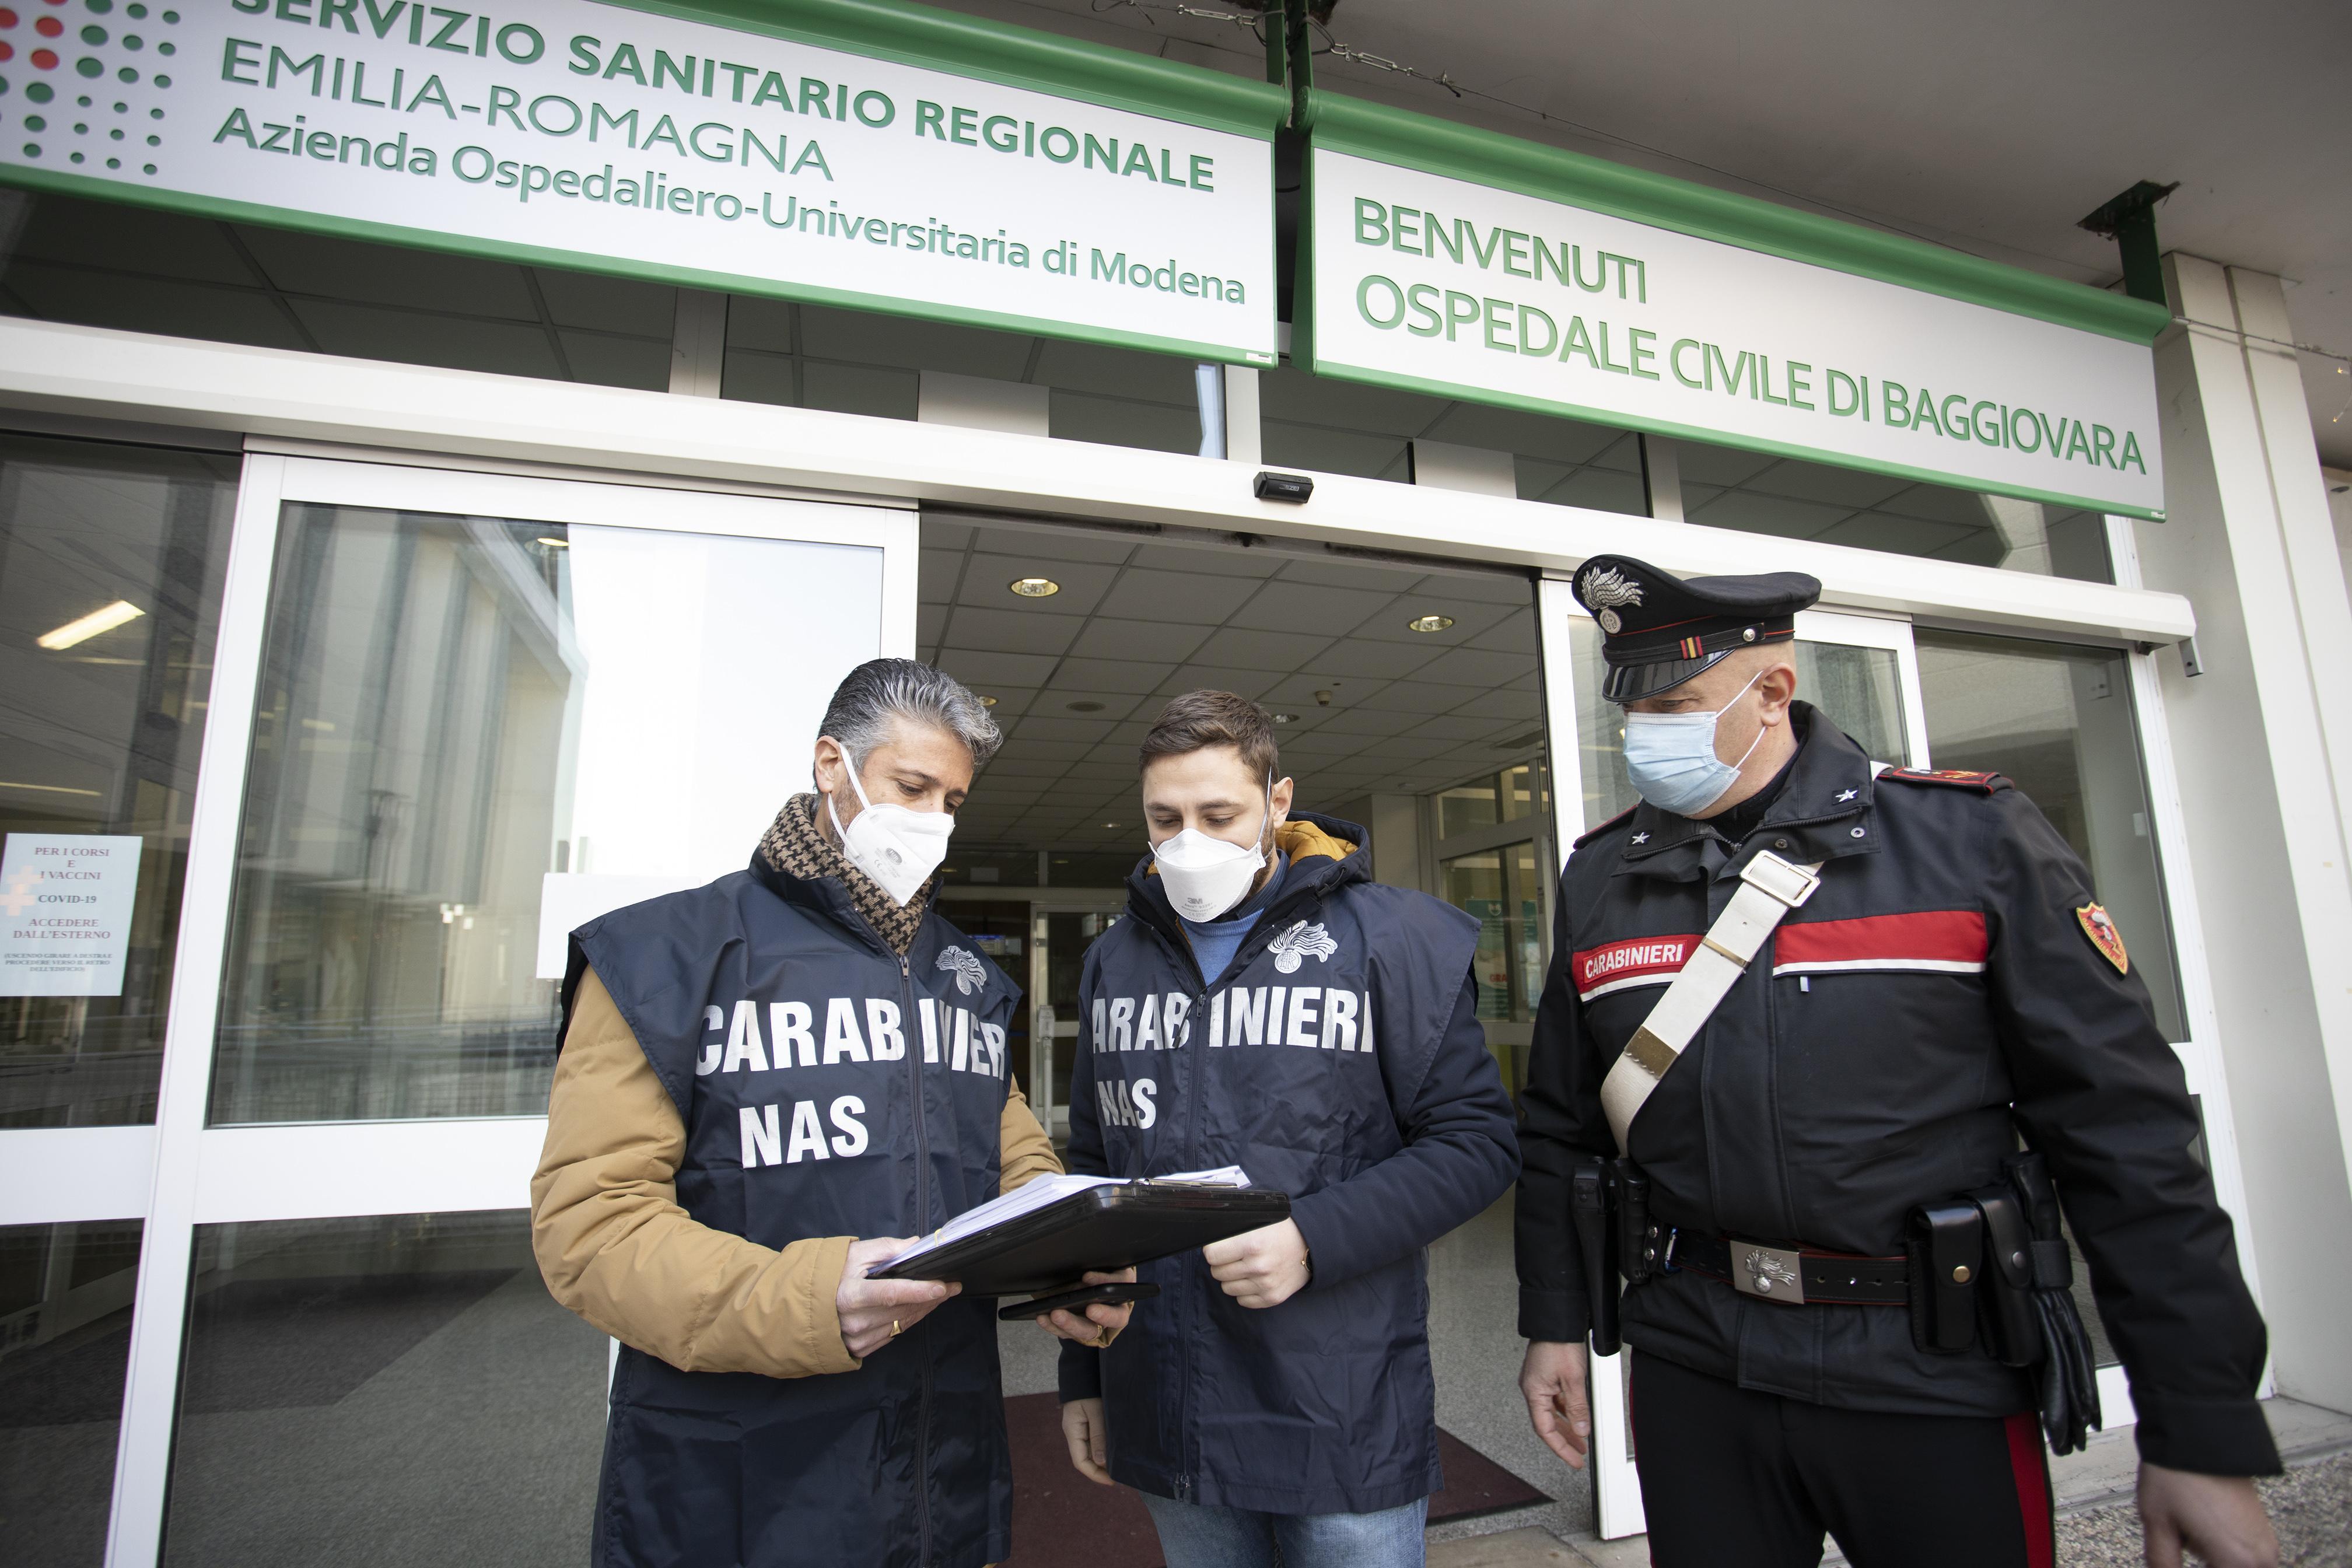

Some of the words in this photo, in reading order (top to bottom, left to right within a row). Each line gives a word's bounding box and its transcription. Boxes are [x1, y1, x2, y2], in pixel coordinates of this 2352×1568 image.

[221, 37, 834, 181] EMILIA-ROMAGNA
[568, 35, 895, 128] SANITARIO
[915, 99, 1215, 193] REGIONALE
[213, 107, 438, 177] Azienda
[452, 146, 1030, 269] Ospedaliero-Universitaria
[1042, 242, 1077, 278] di
[1091, 249, 1246, 304] Modena
[1354, 197, 1647, 304] BENVENUTI
[1356, 274, 1660, 382] OSPEDALE
[1670, 338, 1815, 412] CIVILE
[1826, 368, 1870, 422] DI
[1882, 380, 2147, 475] BAGGIOVARA
[34, 847, 59, 855] PER
[62, 848, 68, 856] I
[71, 848, 110, 856] CORSI
[40, 871, 46, 879] I
[48, 871, 102, 880] VACCINI
[29, 919, 99, 928] ACCEDERE
[38, 895, 97, 904] COVID-19
[1585, 943, 1685, 978] CARABINIERI
[695, 998, 1006, 1081] CARABINIER
[1093, 986, 1373, 1054] ARABINIERI
[739, 1095, 869, 1169] NAS
[1097, 1078, 1157, 1130] NAS
